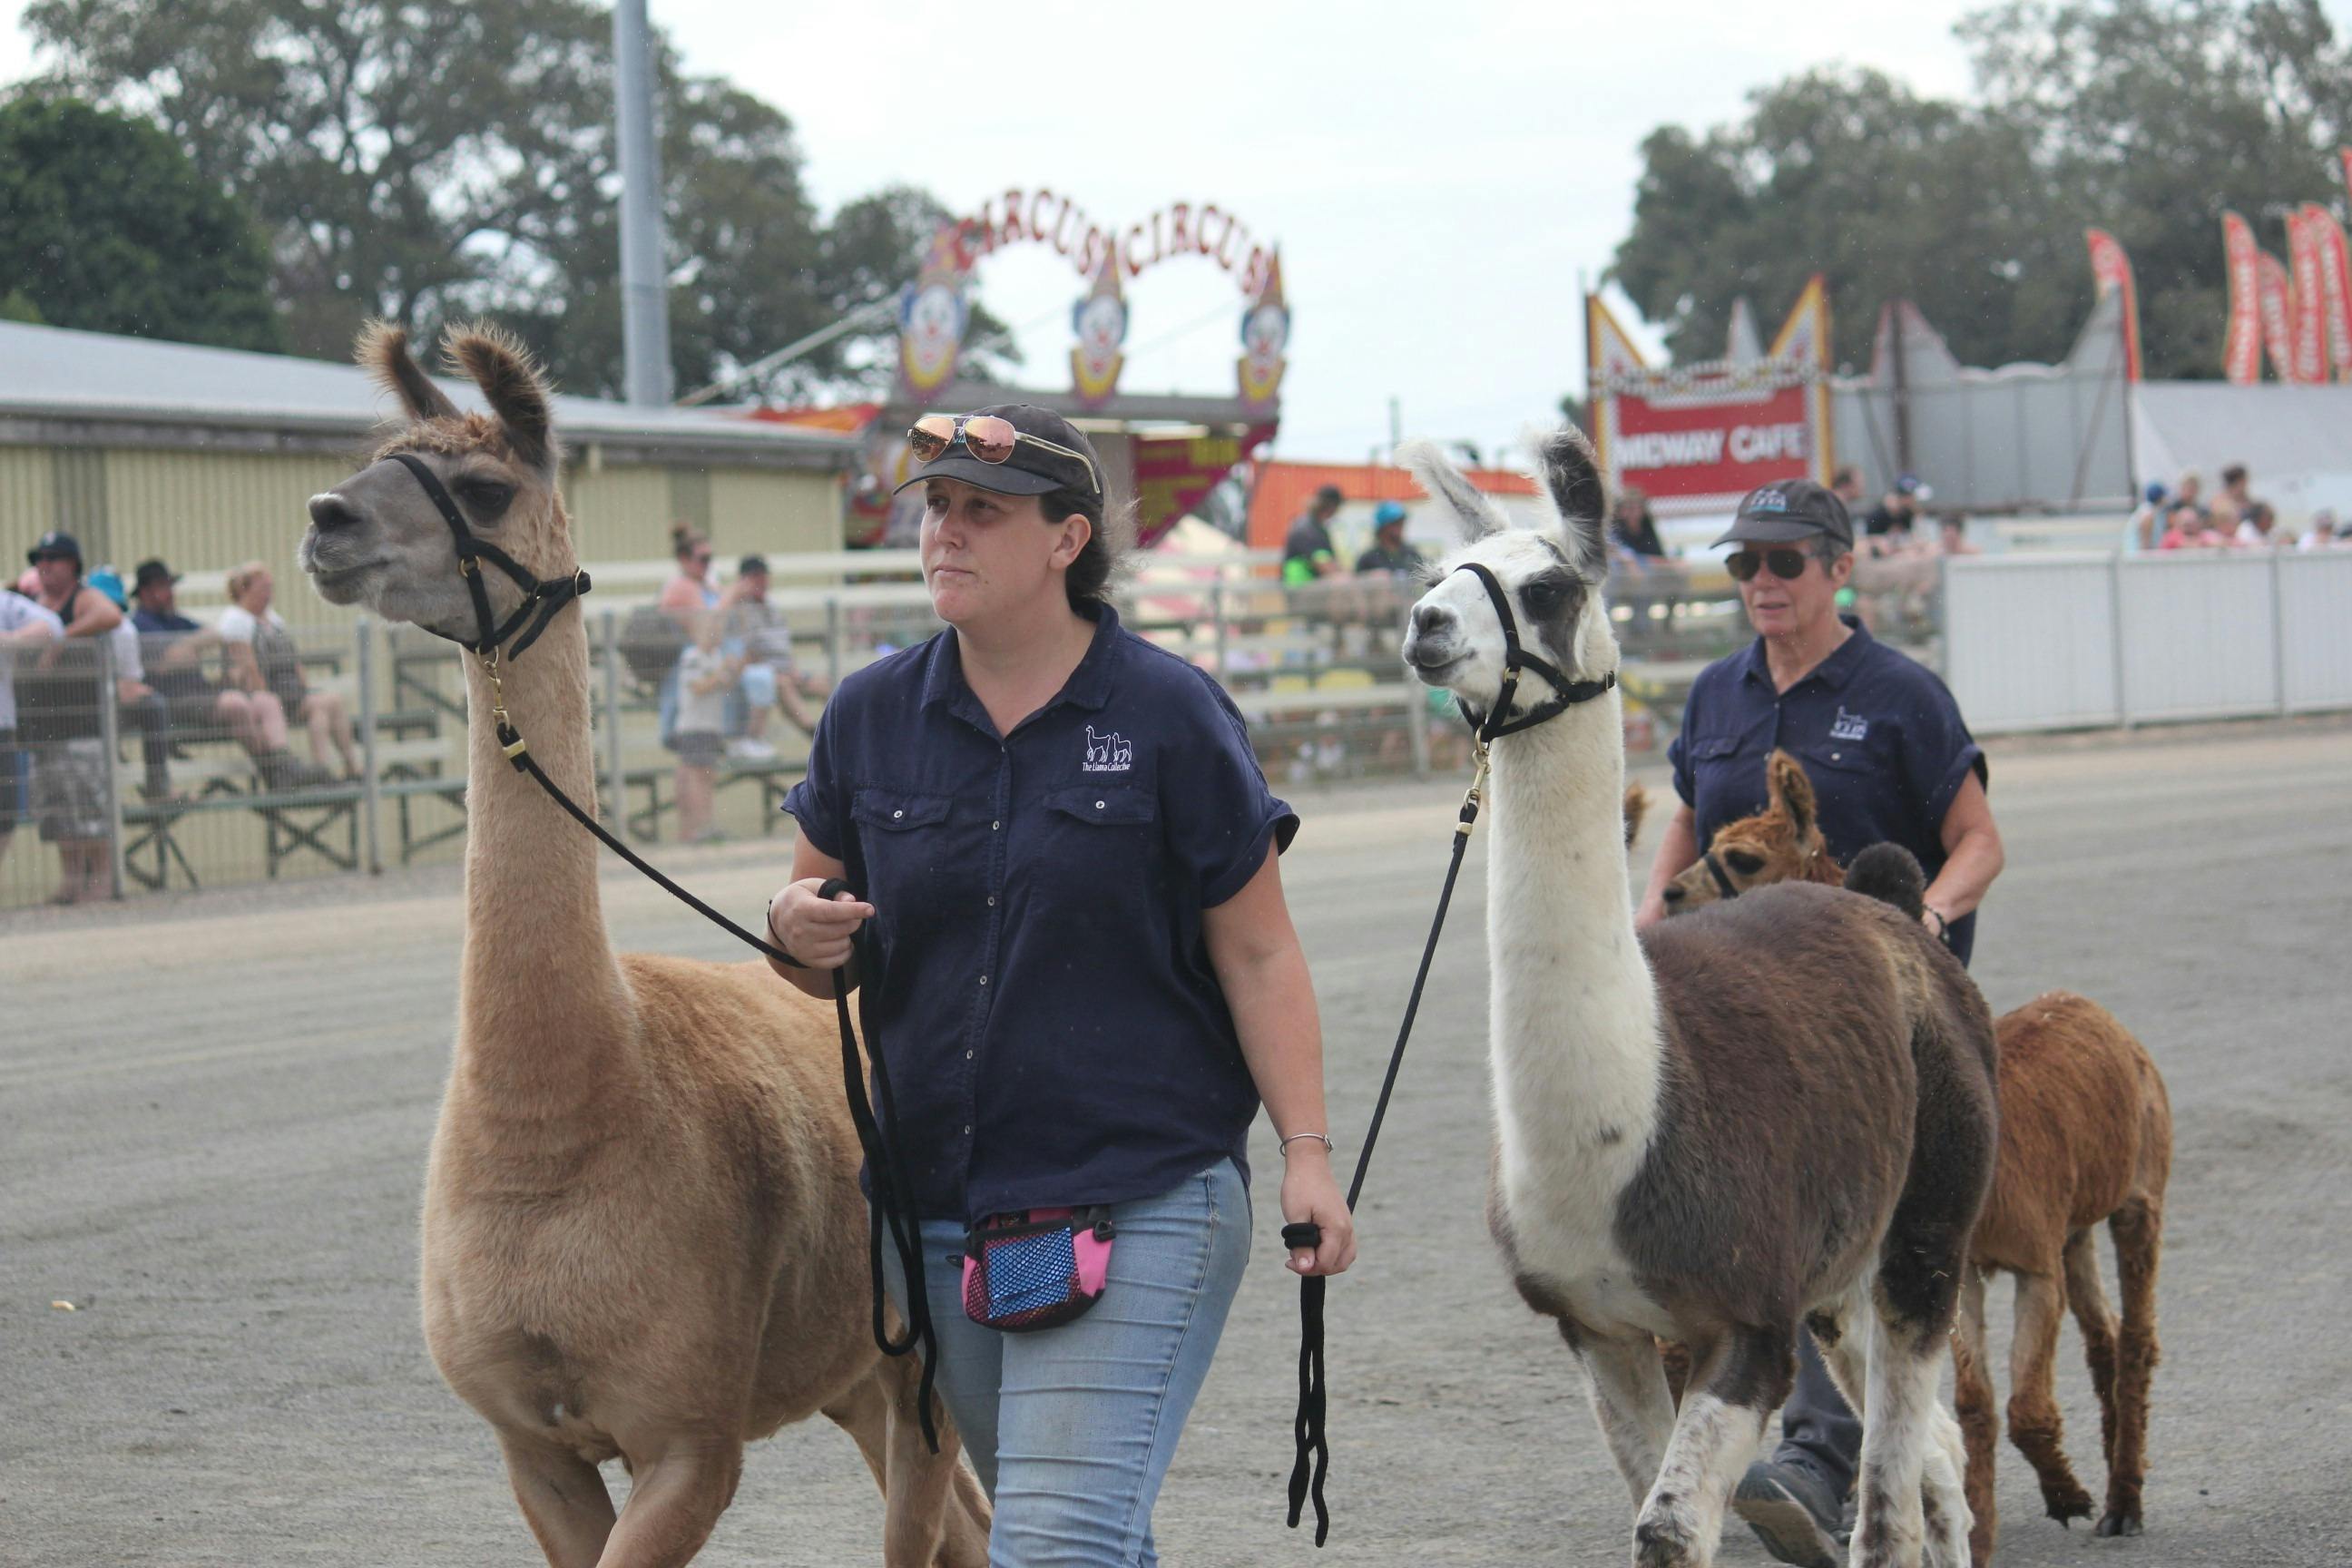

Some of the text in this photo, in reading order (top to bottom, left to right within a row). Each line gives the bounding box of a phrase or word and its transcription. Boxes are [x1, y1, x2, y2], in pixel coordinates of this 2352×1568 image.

[952, 189, 1102, 276] CIRCUS
[1128, 202, 1270, 296] CIRCUS
[1615, 424, 1804, 467] MIDWAY CAFE
[1083, 761, 1131, 771] The Llama Collective
